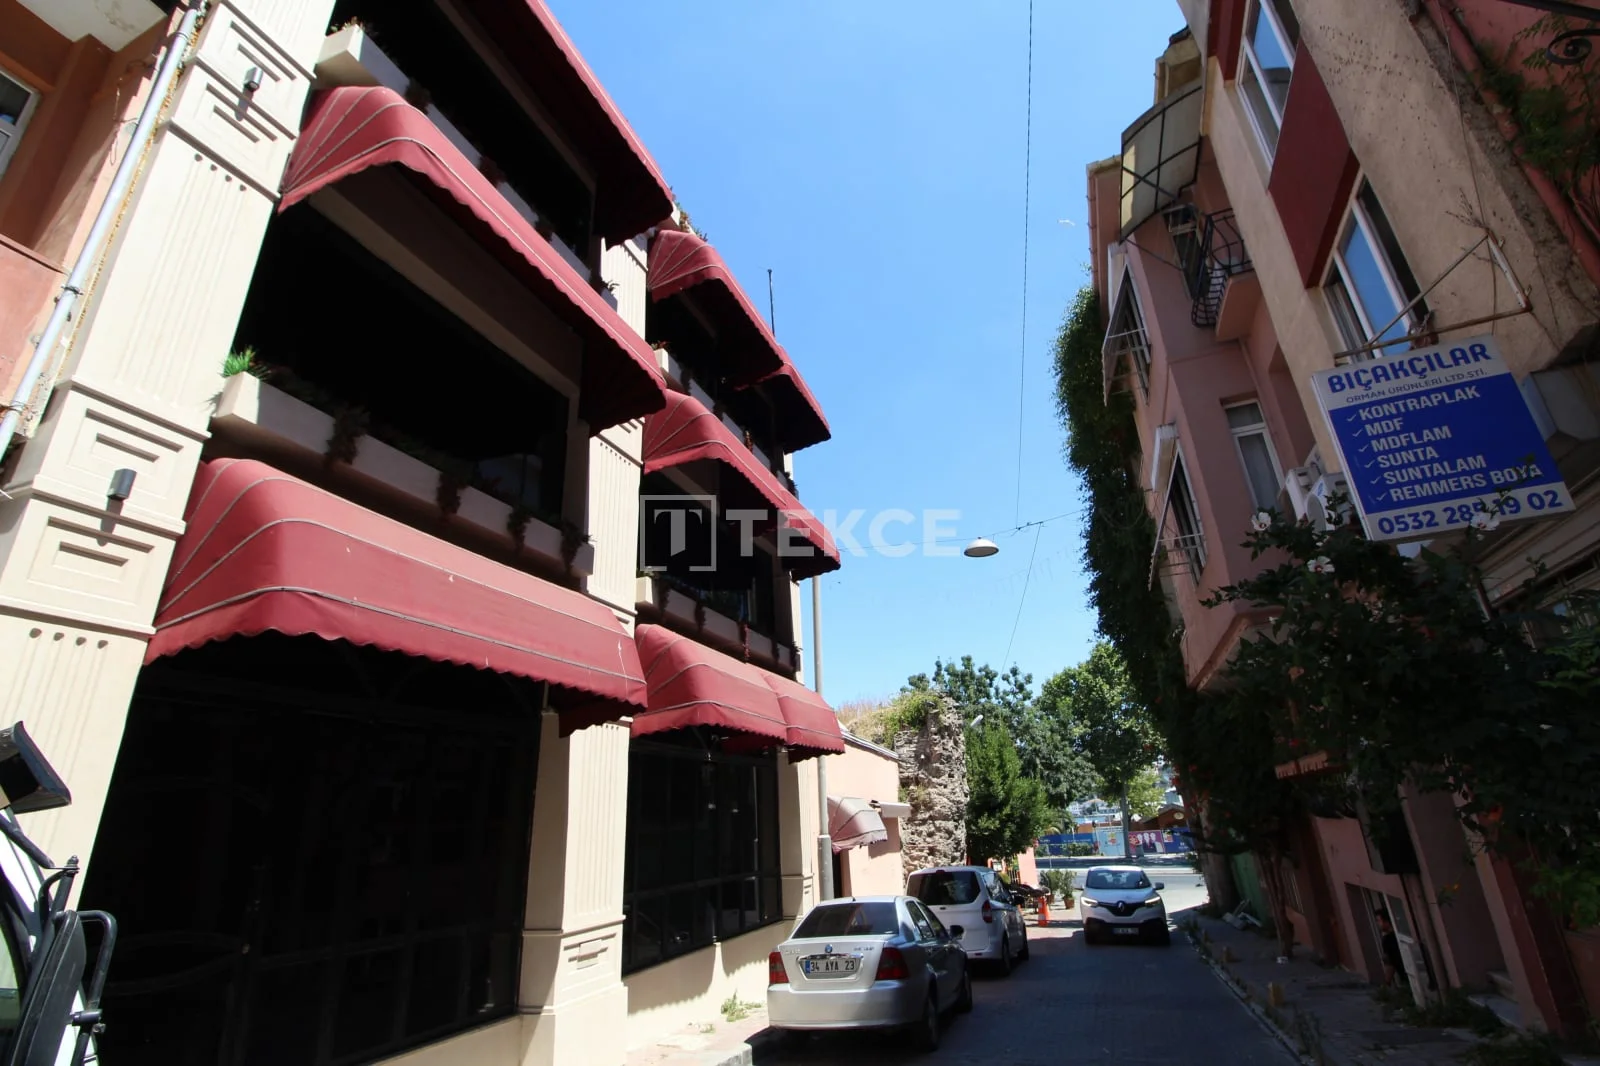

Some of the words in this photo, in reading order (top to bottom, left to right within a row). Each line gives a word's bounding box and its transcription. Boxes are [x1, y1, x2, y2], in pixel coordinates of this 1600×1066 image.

[1327, 343, 1491, 393] BIÇAKÇILAR
[1346, 390, 1385, 403] ORMAN
[1387, 378, 1443, 395] ÜRÜNLERİ
[1359, 386, 1480, 421] KONTRAPLAK
[1365, 417, 1405, 437] MDF
[1371, 425, 1452, 453] MDFLAM
[1377, 447, 1439, 468] SUNTA
[1384, 455, 1487, 485] SUNTALAM
[1390, 473, 1487, 502] REMMERS
[1492, 463, 1542, 485] BOYA
[1378, 510, 1439, 534] 0532
[1496, 496, 1521, 516] 19
[1527, 490, 1562, 510] 02
[811, 962, 820, 971] 34
[825, 961, 839, 971] AYA
[845, 960, 854, 970] 23
